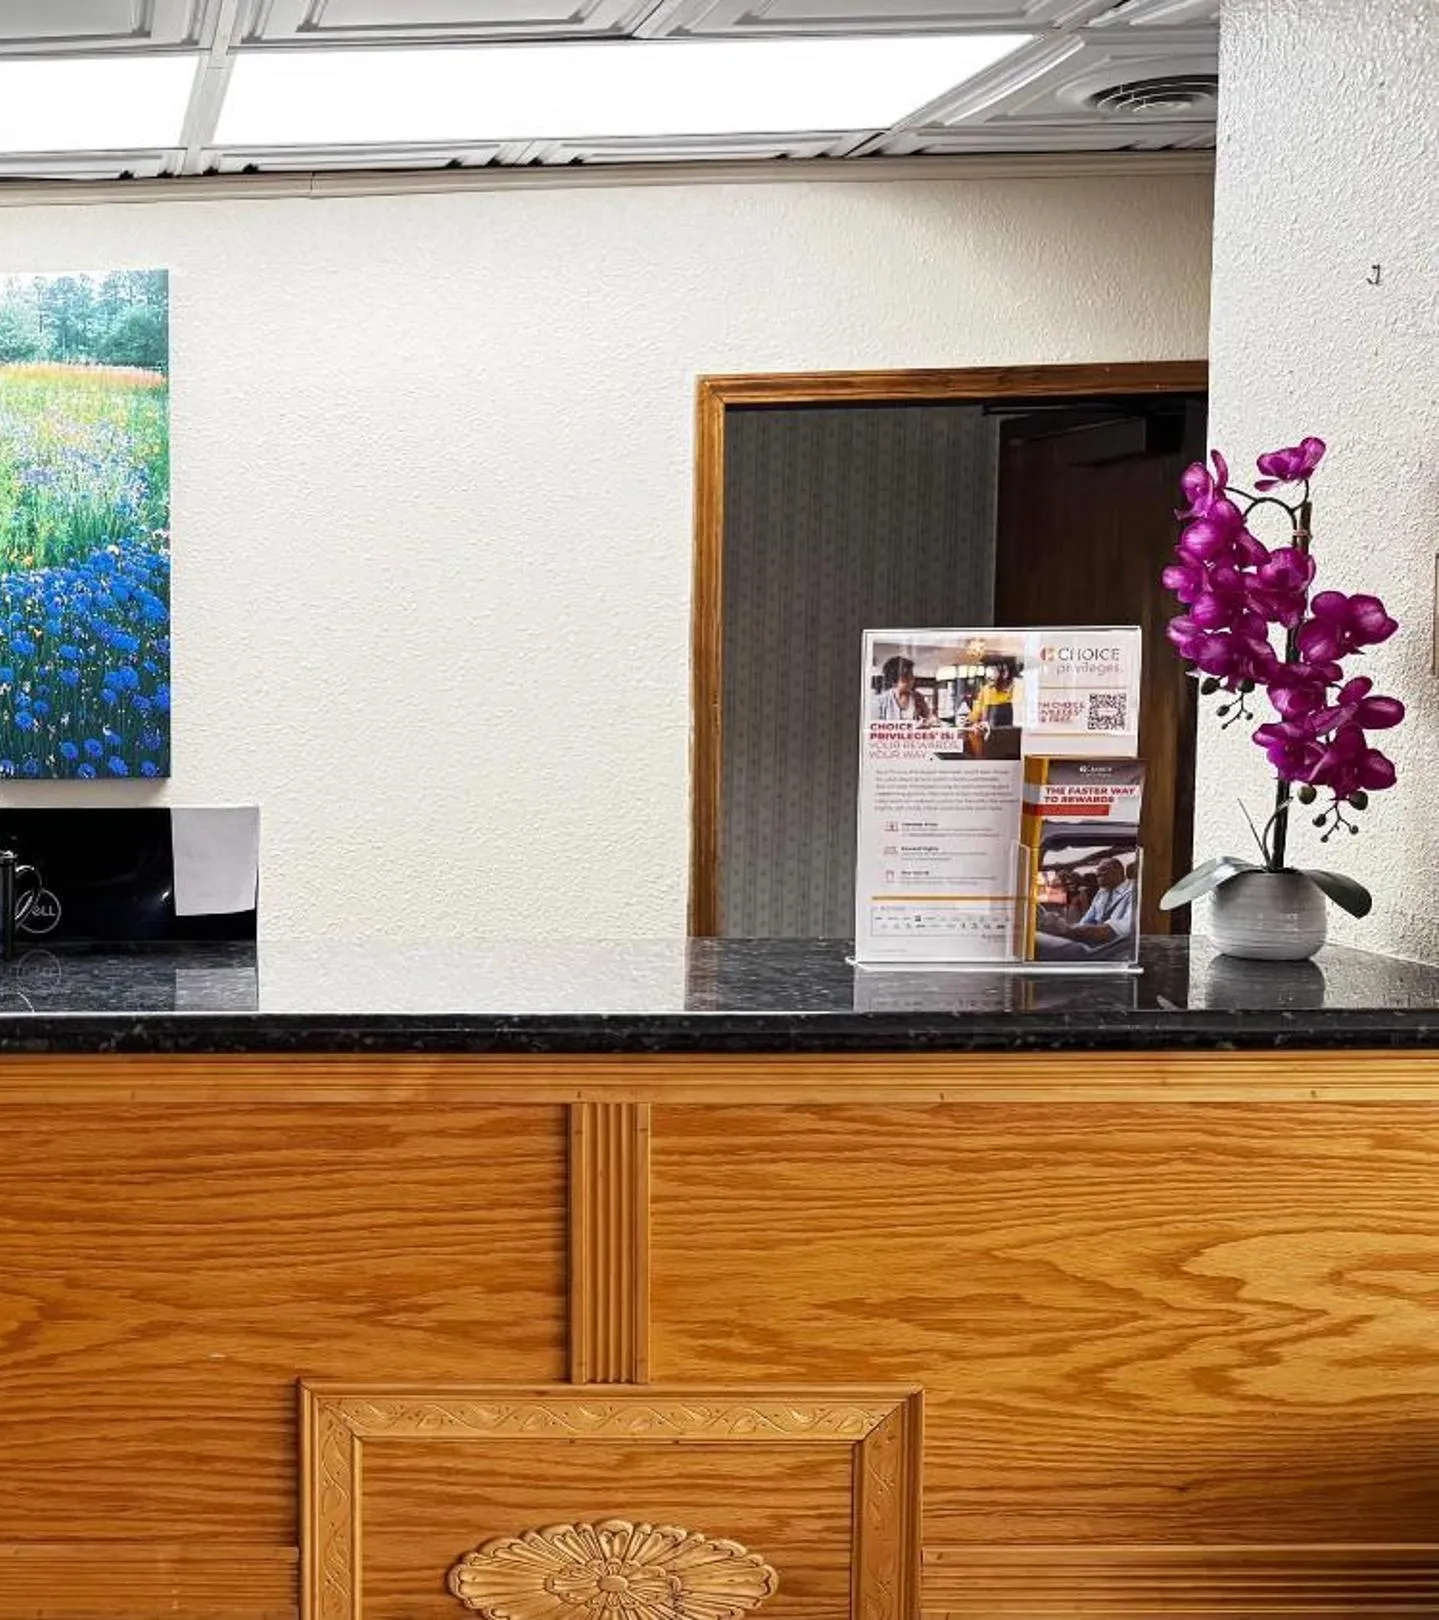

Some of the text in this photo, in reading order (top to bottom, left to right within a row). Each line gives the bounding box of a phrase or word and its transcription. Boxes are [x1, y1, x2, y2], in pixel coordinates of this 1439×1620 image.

[1058, 647, 1121, 661] CHOICE
[870, 722, 913, 731] CHOICE
[1046, 786, 1136, 795] THE FASTER WAY
